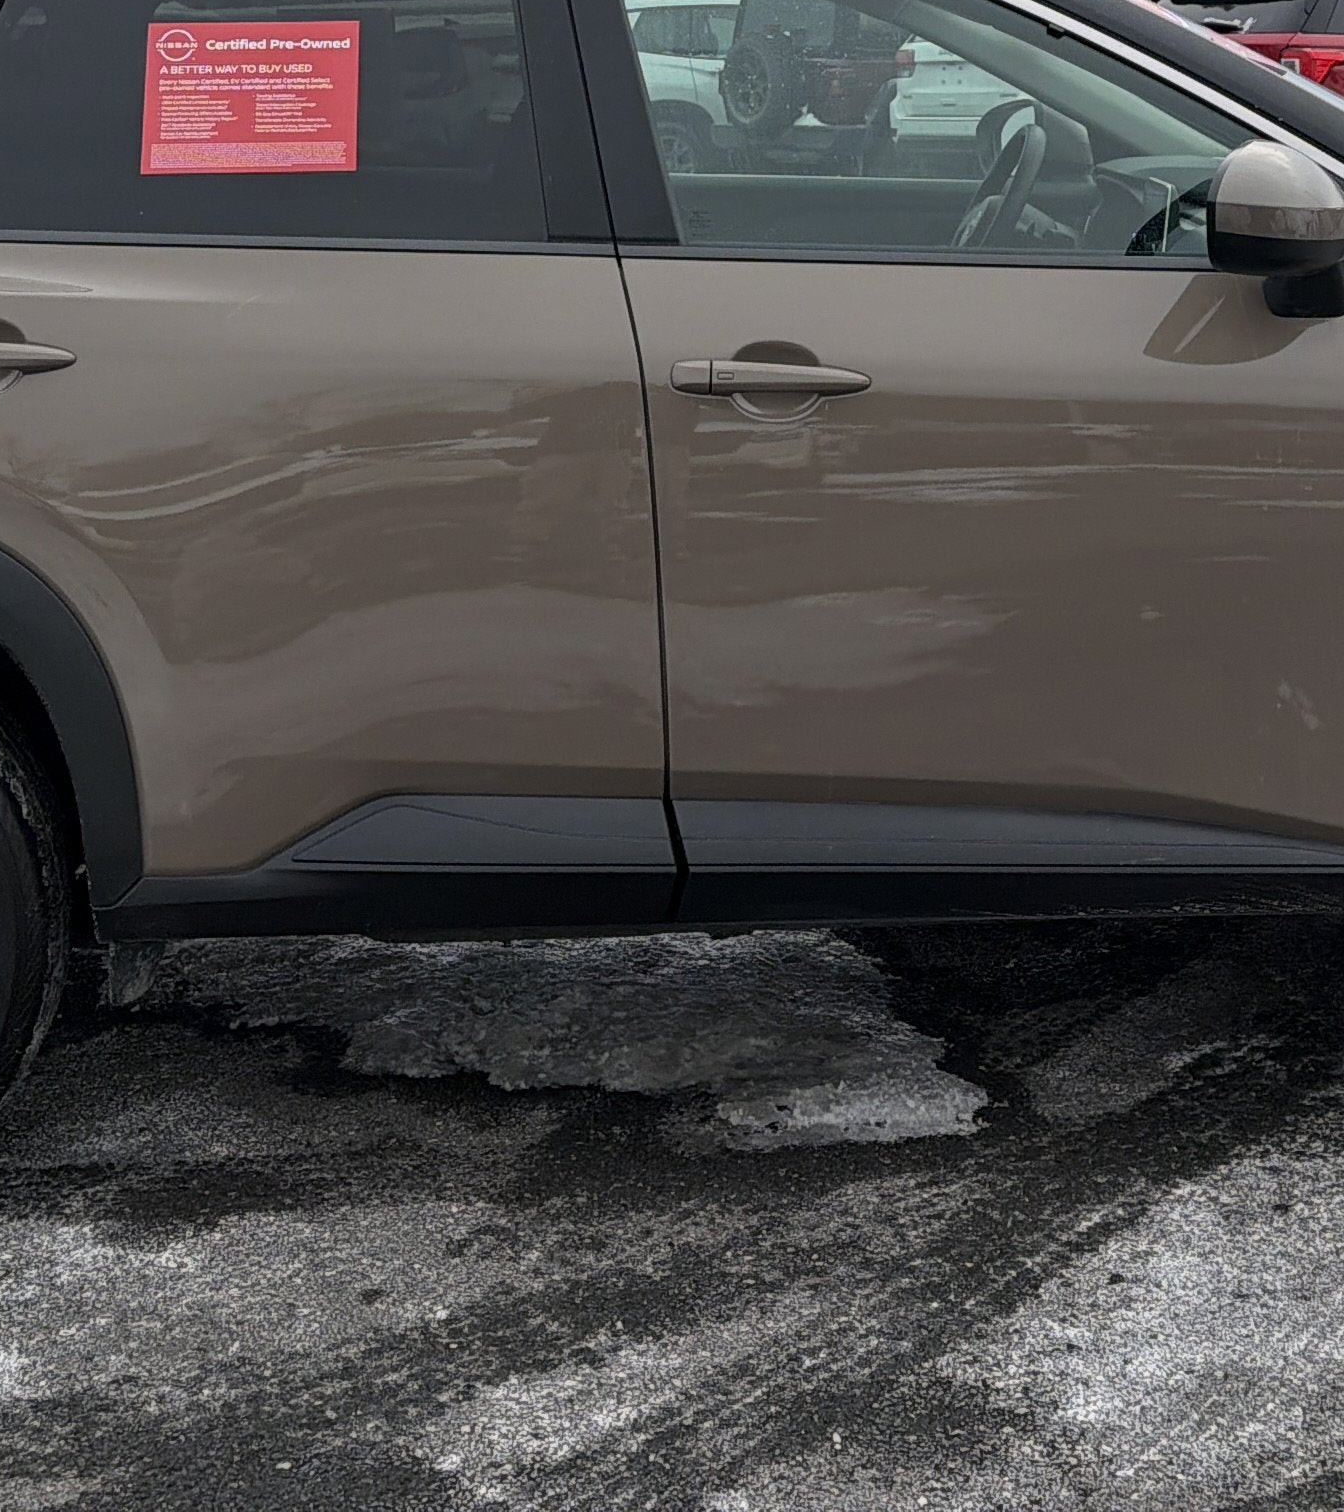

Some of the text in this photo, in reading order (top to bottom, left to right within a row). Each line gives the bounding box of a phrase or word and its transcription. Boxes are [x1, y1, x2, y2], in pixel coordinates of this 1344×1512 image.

[155, 41, 198, 49] NISSAN
[205, 37, 351, 50] Certified Pre-Owned
[159, 63, 313, 75] A BETTER WAY TO BUY USED
